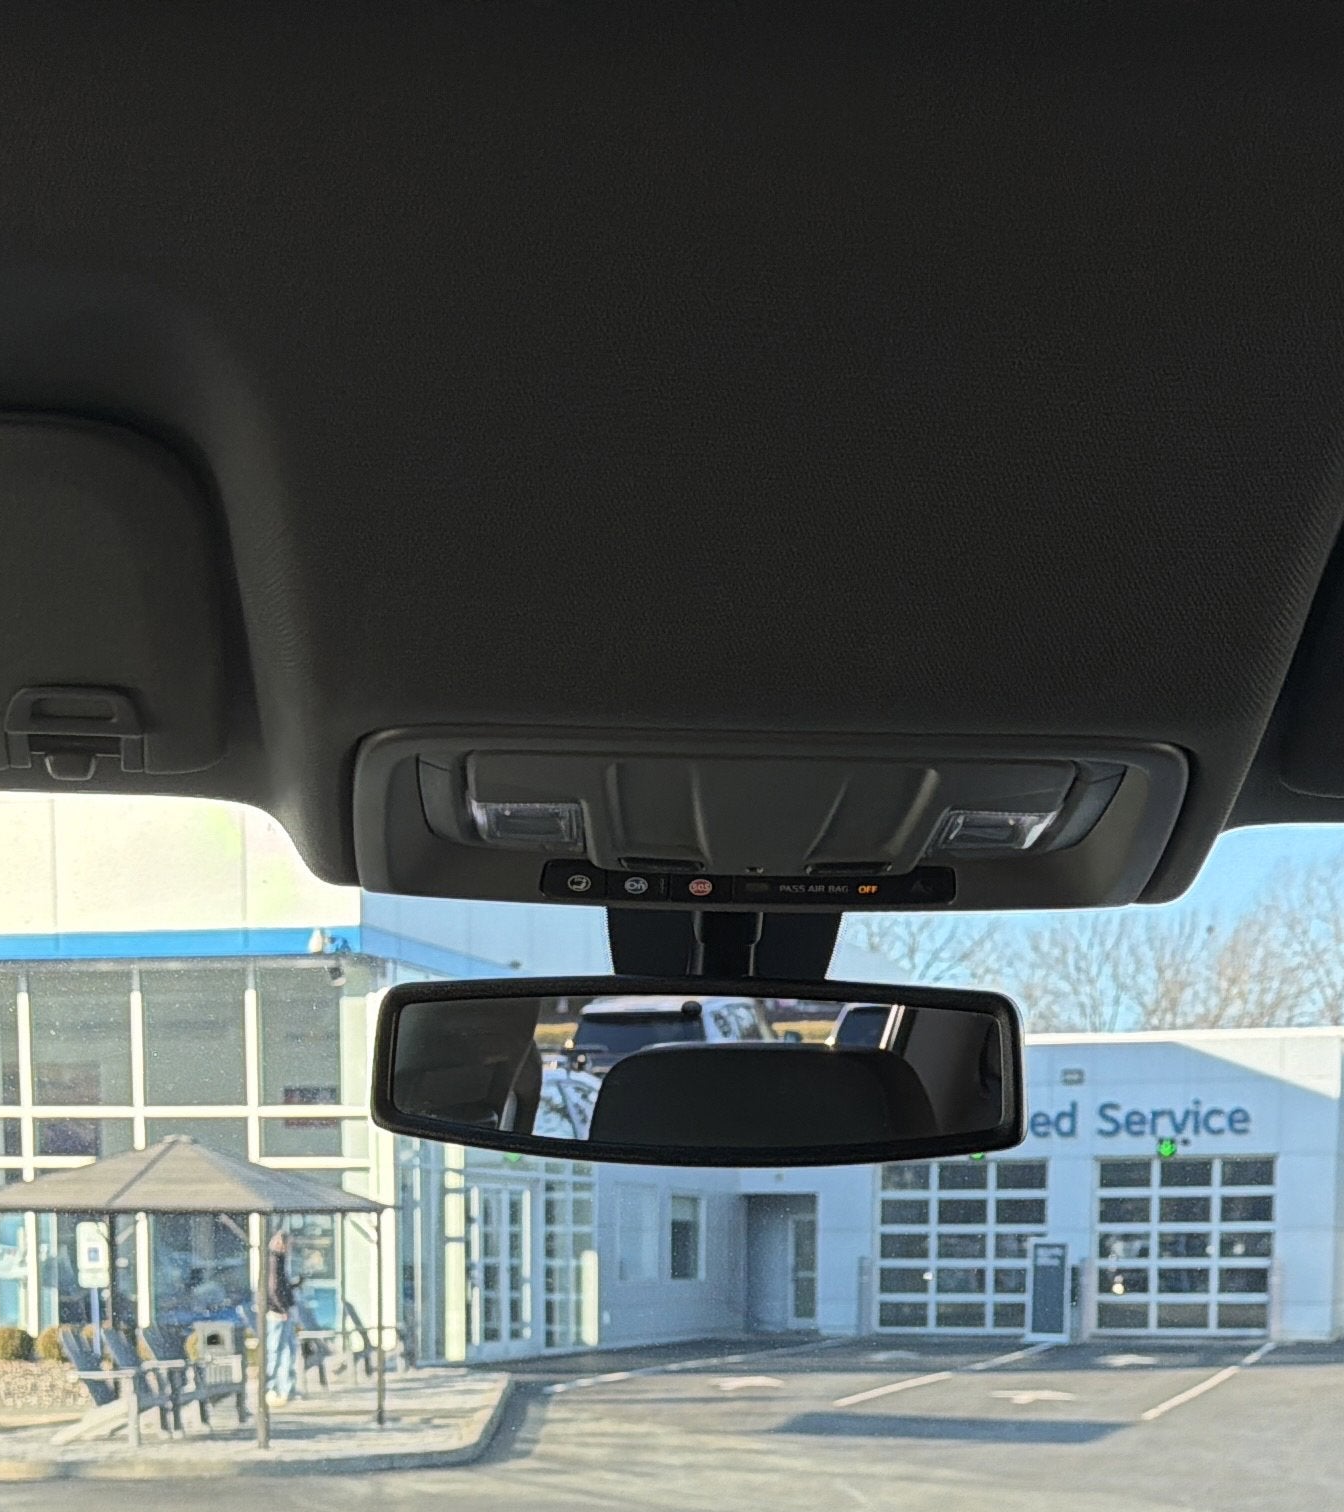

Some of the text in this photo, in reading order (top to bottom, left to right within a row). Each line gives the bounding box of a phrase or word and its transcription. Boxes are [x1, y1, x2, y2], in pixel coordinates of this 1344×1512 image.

[780, 884, 879, 895] PASS AIR BAG OFF
[1097, 1099, 1251, 1138] Service
